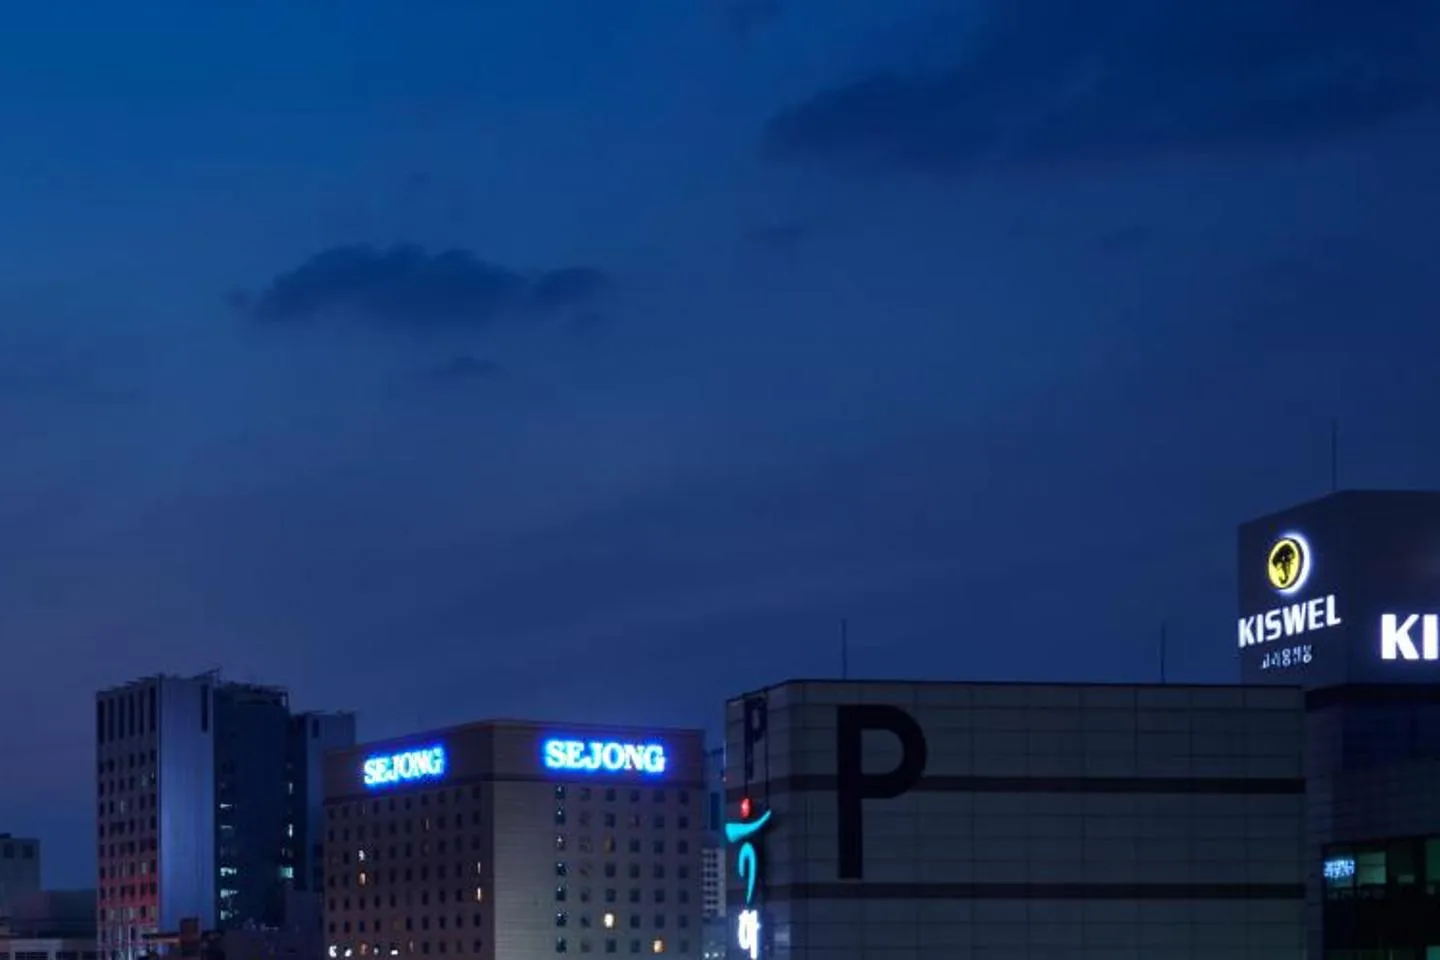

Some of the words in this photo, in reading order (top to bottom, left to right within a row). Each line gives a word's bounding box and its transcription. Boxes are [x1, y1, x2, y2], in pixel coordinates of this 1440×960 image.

[1237, 594, 1341, 648] KISWEL
[1379, 613, 1440, 661] KI
[363, 746, 444, 787] SEJONG
[544, 739, 667, 774] SEJONG
[836, 704, 929, 879] P
